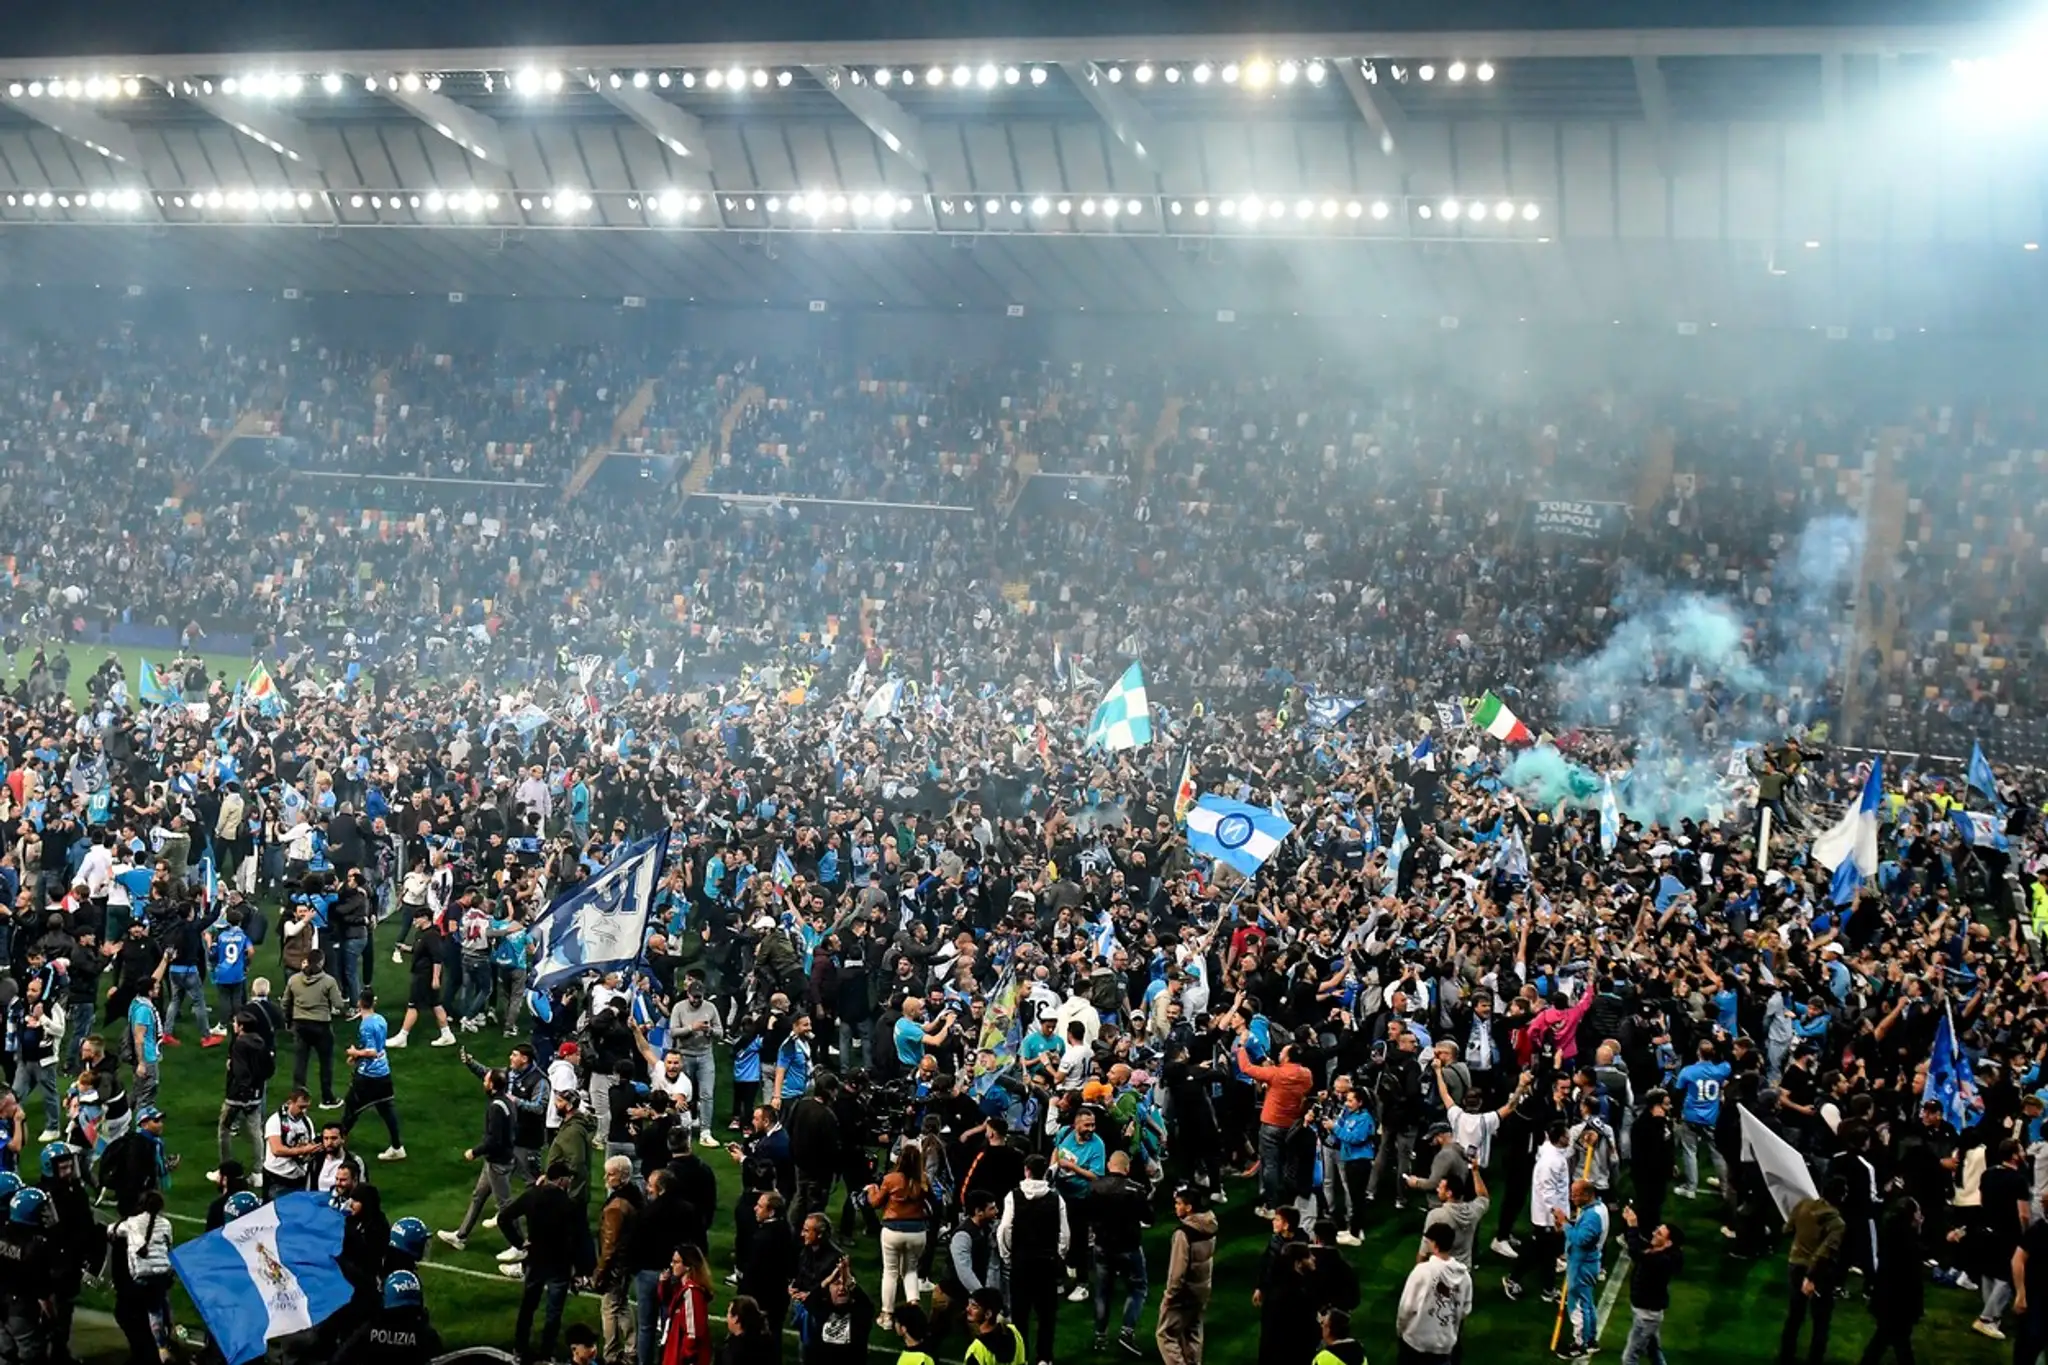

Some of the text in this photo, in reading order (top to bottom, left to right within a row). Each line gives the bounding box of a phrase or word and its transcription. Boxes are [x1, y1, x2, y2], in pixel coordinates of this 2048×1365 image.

[1539, 502, 1594, 516] FORZA
[1535, 513, 1602, 529] NAPOLI
[92, 794, 107, 809] 10
[225, 943, 239, 964] 9
[1696, 1079, 1720, 1101] 10
[370, 1328, 416, 1346] POLIZIA
